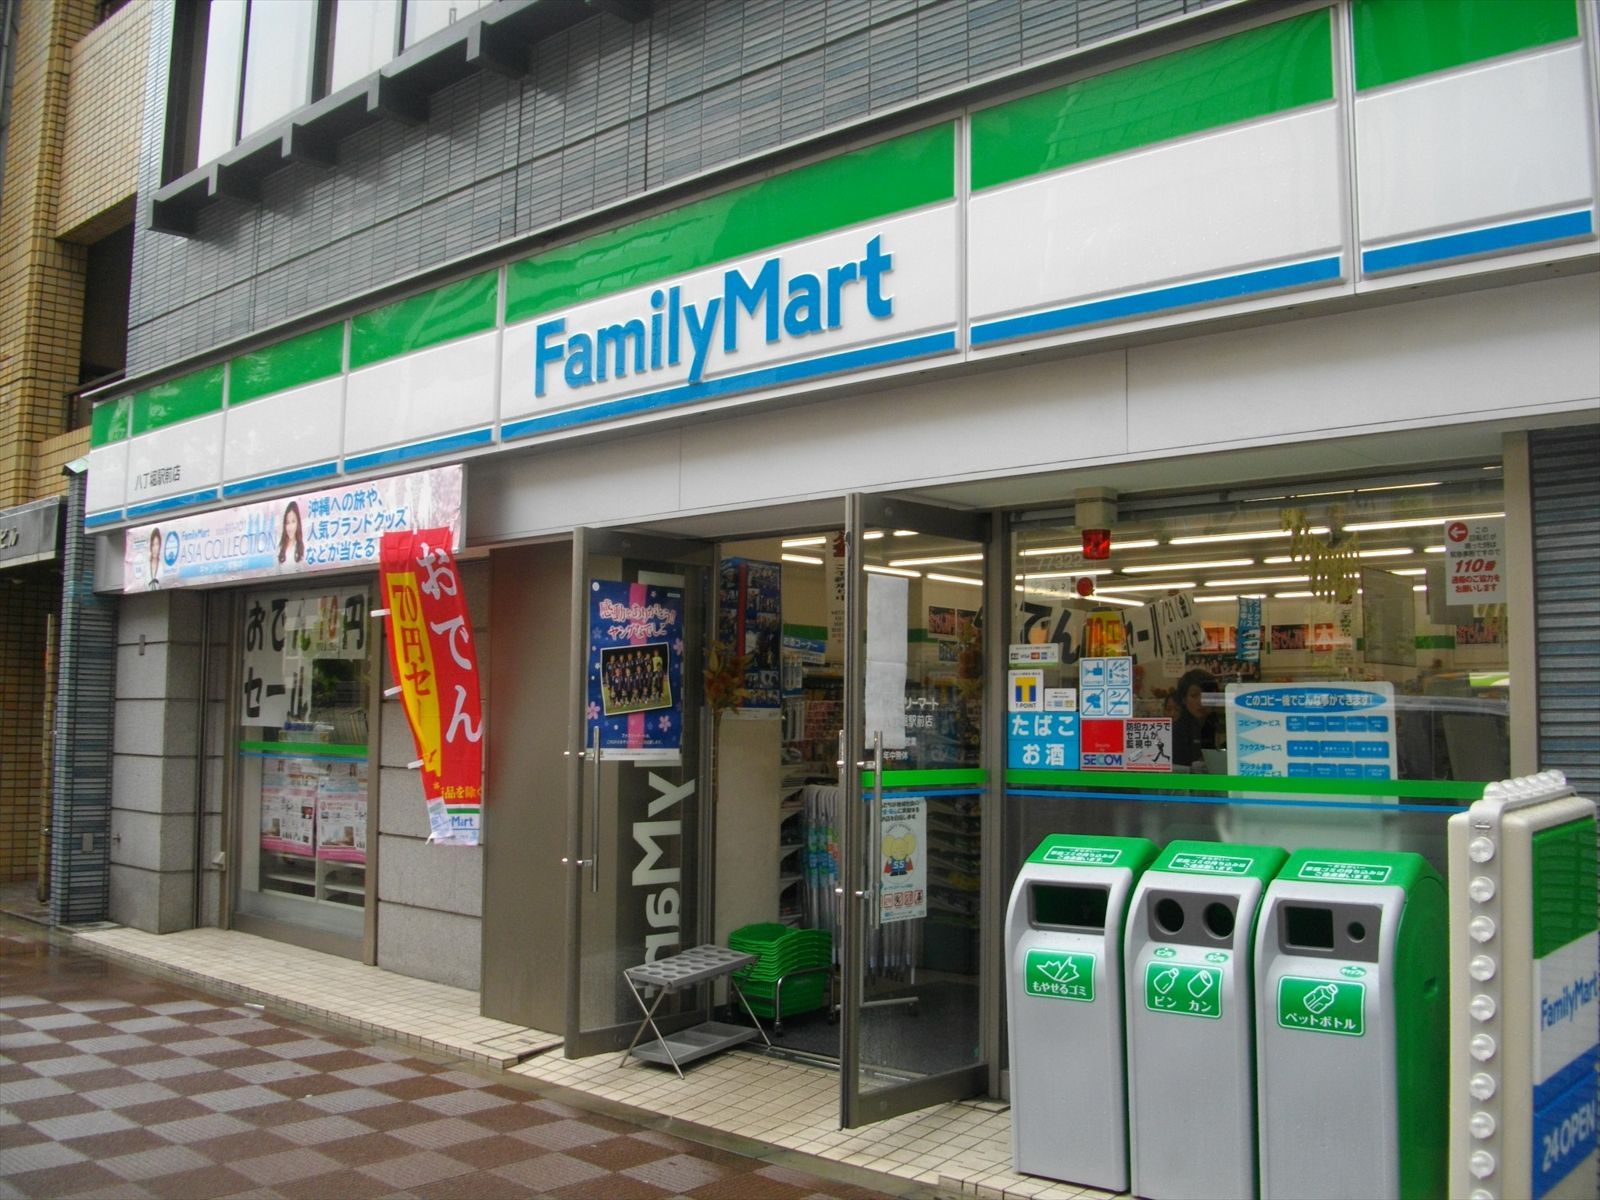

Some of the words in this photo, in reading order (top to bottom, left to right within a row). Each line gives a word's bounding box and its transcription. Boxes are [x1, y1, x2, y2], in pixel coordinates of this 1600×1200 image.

[534, 232, 895, 398] FamilyMart
[308, 488, 383, 518] 沖縄への旅や、
[307, 506, 409, 541] 人気ブランドグッズ
[181, 543, 203, 563] ASIA
[204, 531, 277, 561] COLLECTION
[306, 537, 376, 565] などが当たる
[1456, 559, 1496, 573] 110番
[1456, 583, 1497, 593] お願いします
[416, 542, 482, 744] おでん
[1012, 714, 1075, 736] たばこ
[1126, 722, 1170, 731] 防犯カメラで
[1126, 731, 1158, 740] セコムが
[1126, 740, 1152, 748] 監視中
[1022, 743, 1065, 766] お酒
[1083, 754, 1122, 766] SECOM
[1032, 981, 1087, 996] もやせるゴミ
[1154, 996, 1177, 1008] ビン
[1188, 1000, 1212, 1012] カン
[1541, 971, 1598, 1031] FamilyMart
[1285, 1013, 1357, 1030] ペットボトル
